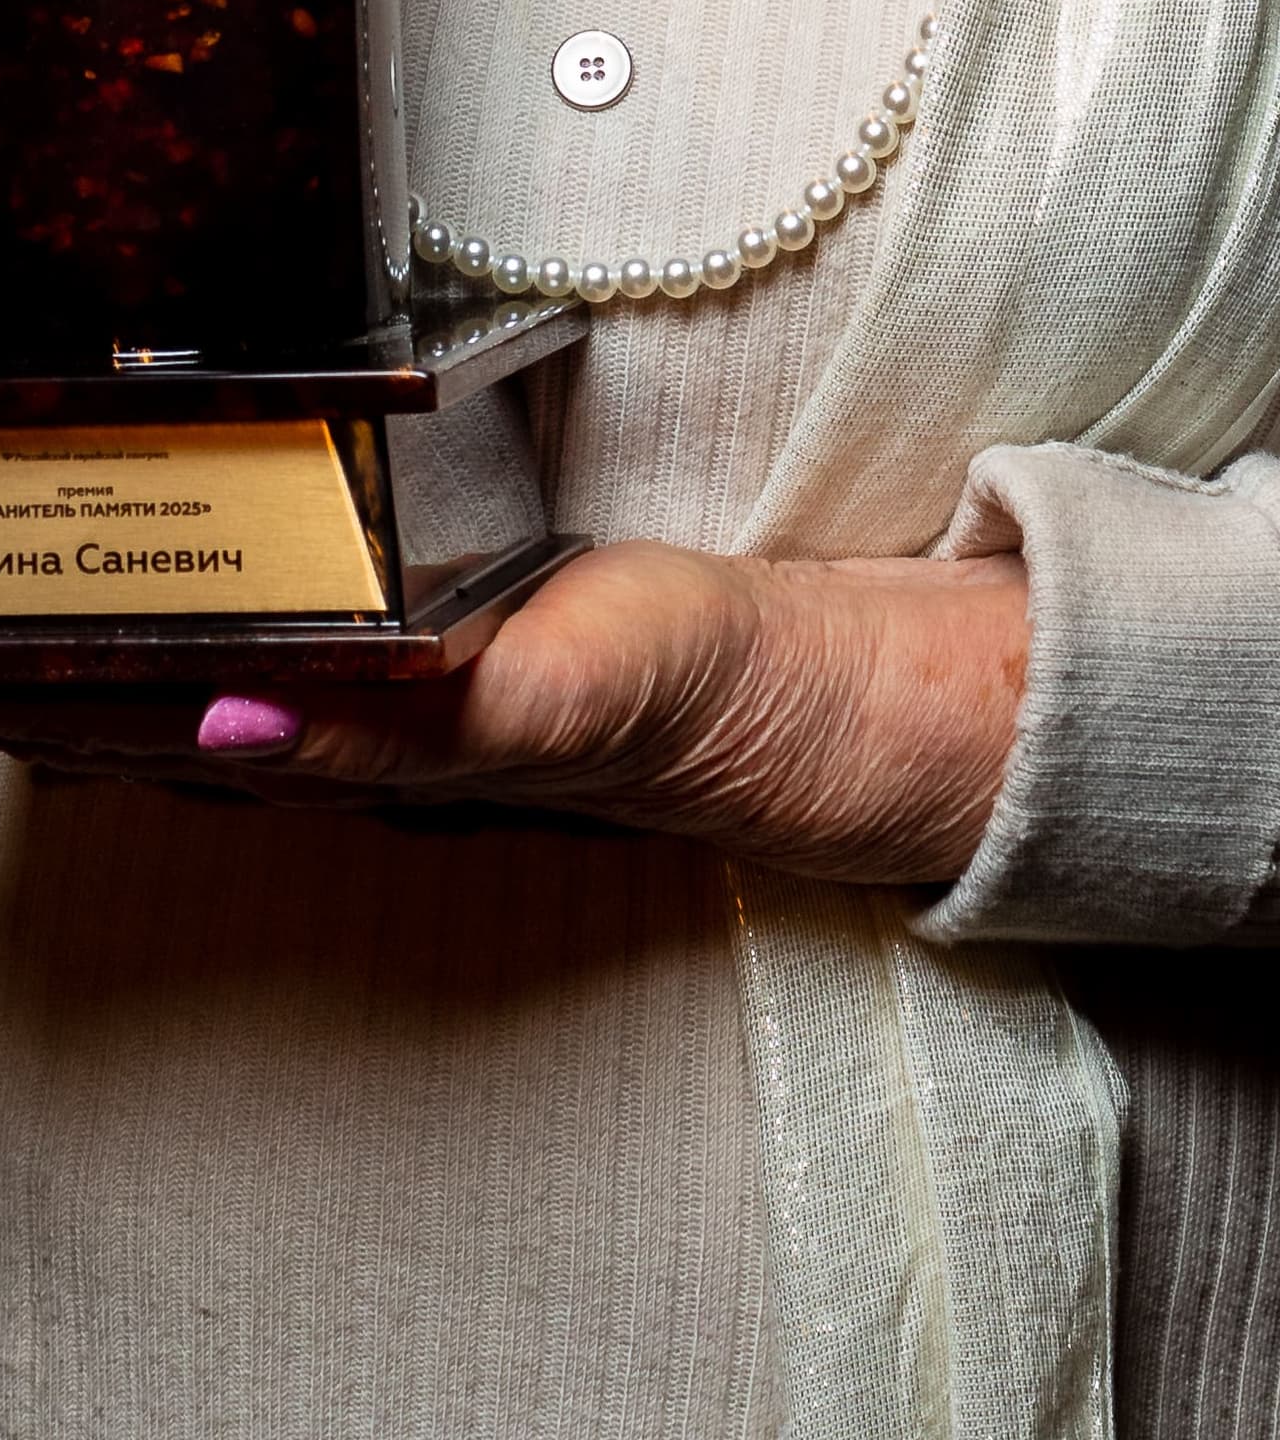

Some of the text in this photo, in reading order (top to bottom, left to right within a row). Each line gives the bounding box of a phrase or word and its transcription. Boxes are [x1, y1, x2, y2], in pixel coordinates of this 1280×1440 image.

[57, 485, 114, 499] премия
[80, 502, 156, 518] ПАМЯТИ
[160, 501, 212, 517] 2025»
[75, 542, 243, 575] Саневич
